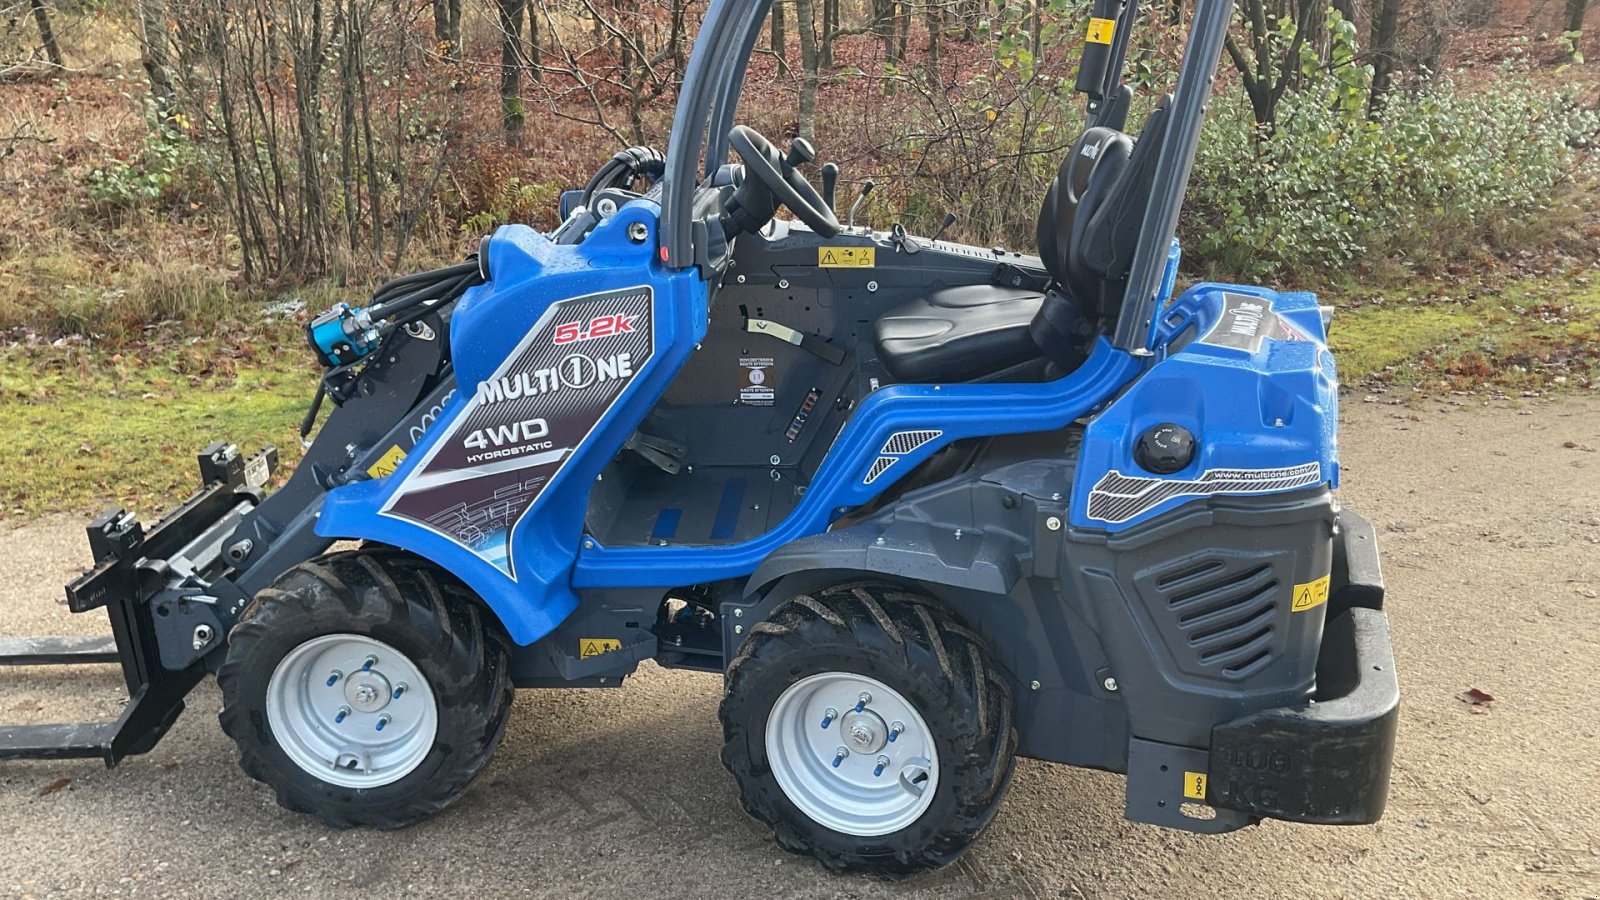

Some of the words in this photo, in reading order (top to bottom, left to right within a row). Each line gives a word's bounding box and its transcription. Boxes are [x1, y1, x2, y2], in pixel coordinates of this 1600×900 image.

[554, 315, 636, 344] 5.2k
[464, 418, 549, 449] 4WD
[467, 441, 552, 463] HYDROSTATIC
[1214, 467, 1308, 479] www.multione.com
